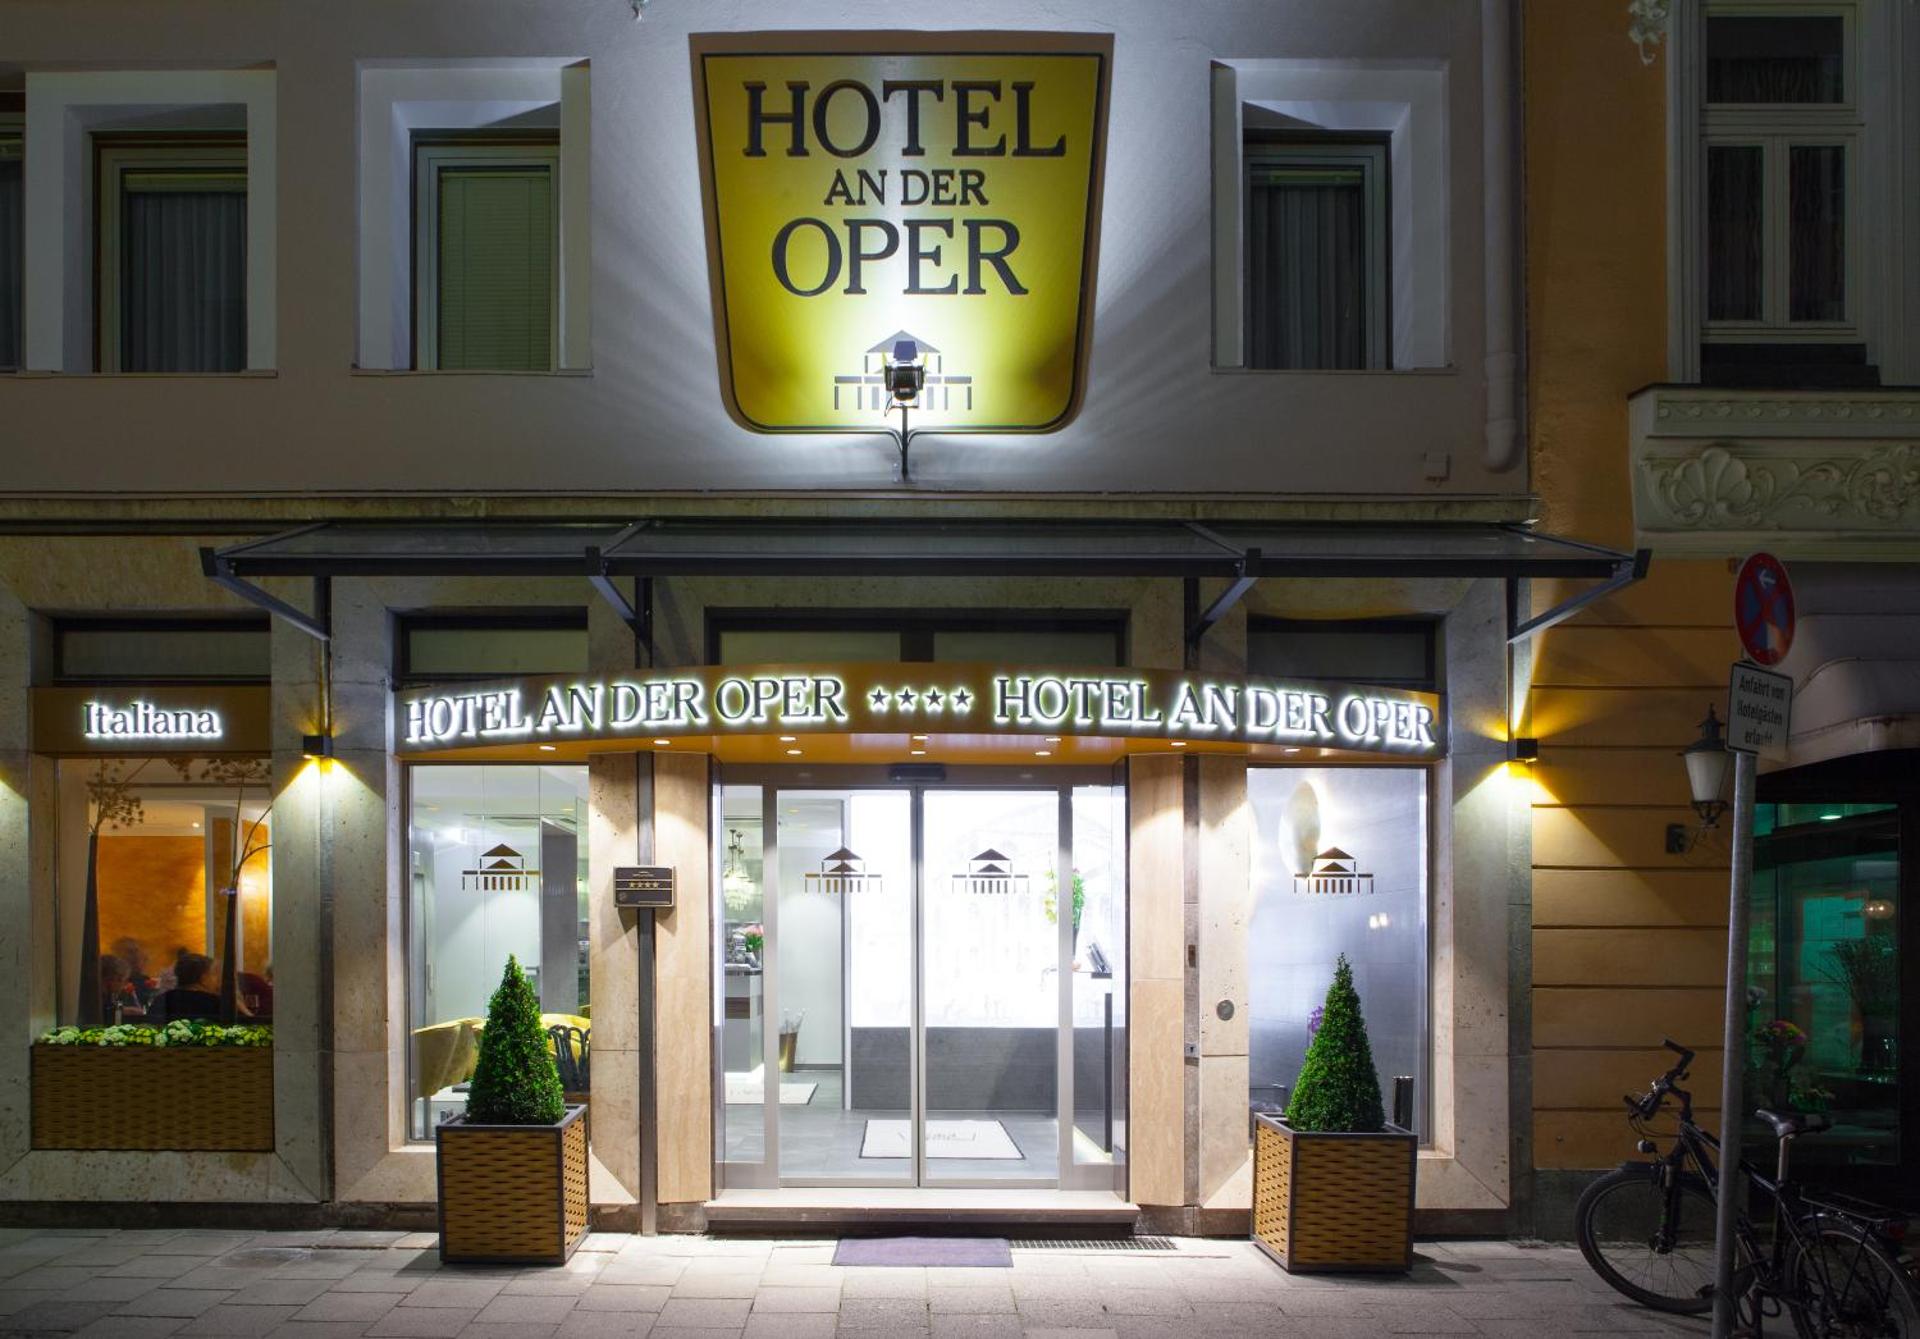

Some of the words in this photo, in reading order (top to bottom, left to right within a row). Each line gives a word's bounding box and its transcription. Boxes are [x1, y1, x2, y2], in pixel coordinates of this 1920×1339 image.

[743, 79, 1067, 158] HOTEL
[823, 169, 888, 205] AN
[901, 169, 990, 205] DER
[771, 217, 1030, 297] OPER
[404, 690, 531, 742] HOTEL
[536, 685, 602, 730] AN
[610, 680, 706, 726] DER
[715, 677, 848, 723] OPER
[995, 676, 1162, 726] HOTEL
[1168, 683, 1240, 731] AN
[1247, 687, 1335, 738] DER
[1337, 695, 1436, 746] OPER
[1739, 675, 1770, 697] Anfahrt
[83, 702, 220, 736] Italiana
[1736, 700, 1784, 725] Hotelgästen
